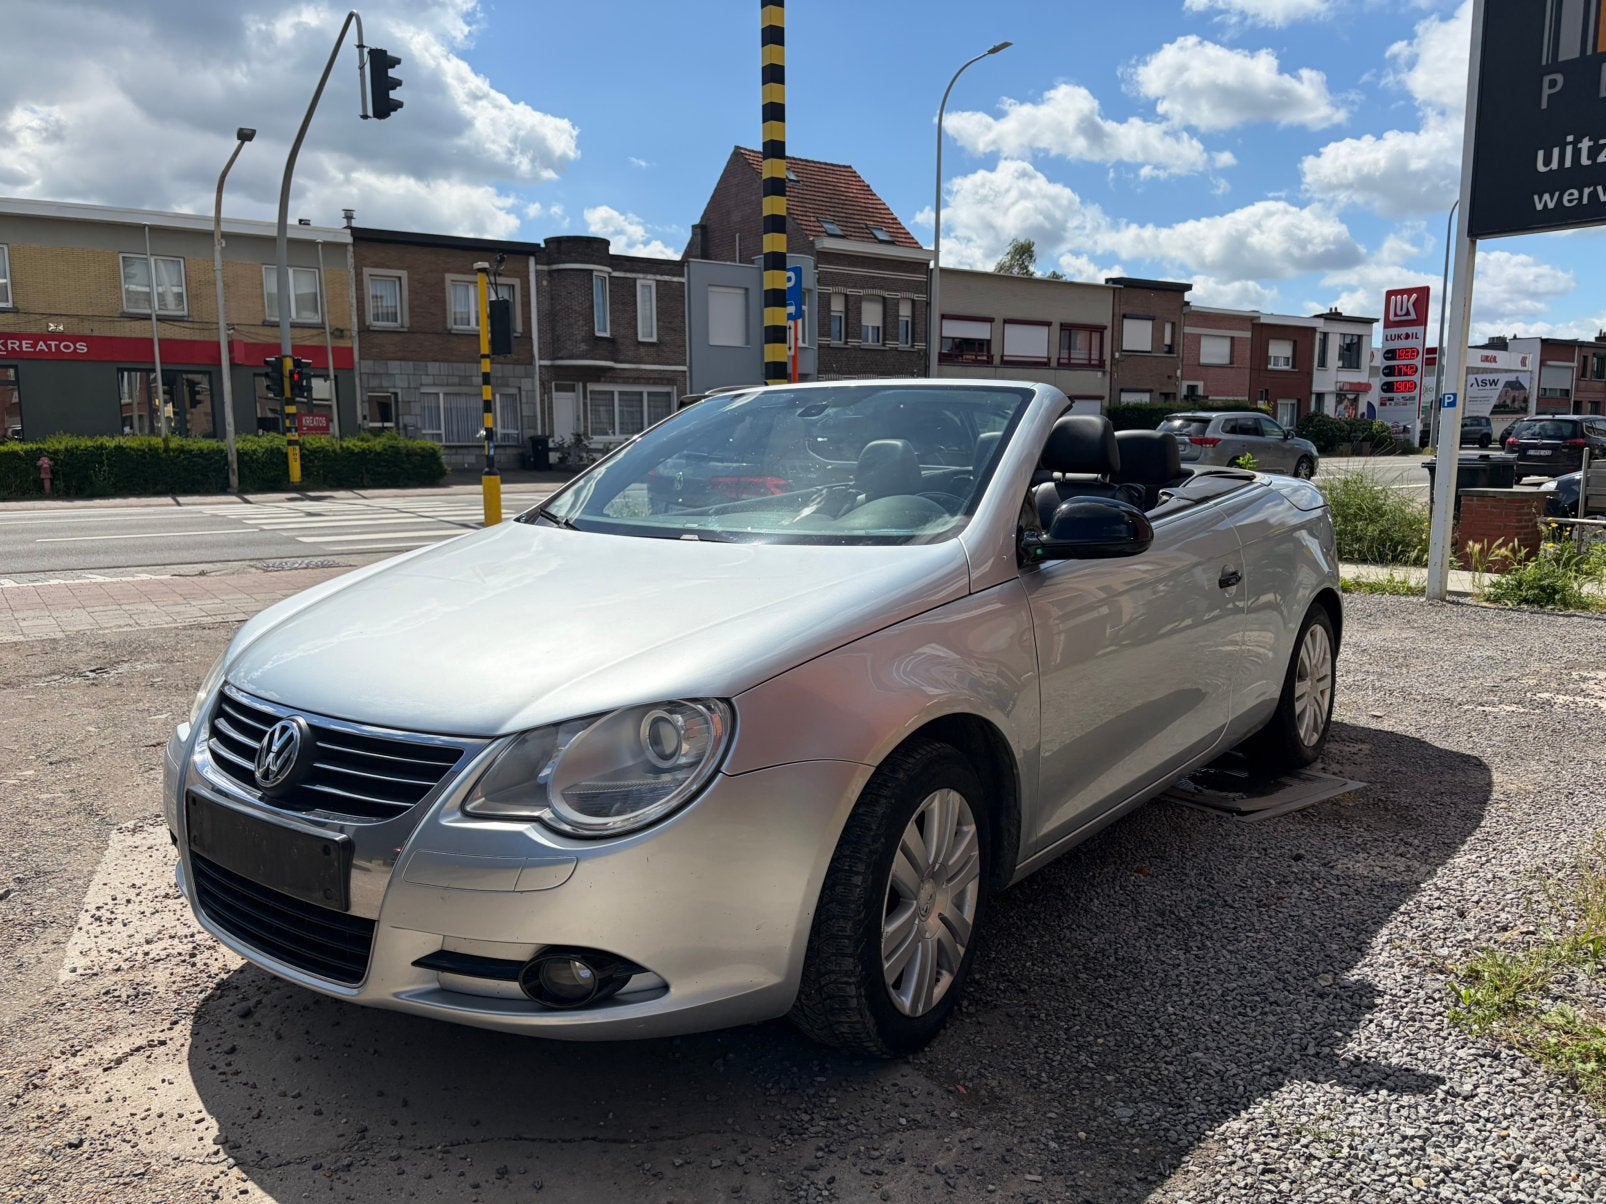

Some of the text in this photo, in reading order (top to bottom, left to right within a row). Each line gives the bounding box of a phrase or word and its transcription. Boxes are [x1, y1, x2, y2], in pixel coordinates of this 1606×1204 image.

[1385, 331, 1420, 342] LUKOIL
[1444, 395, 1454, 407] P
[302, 416, 327, 427] KREATOS
